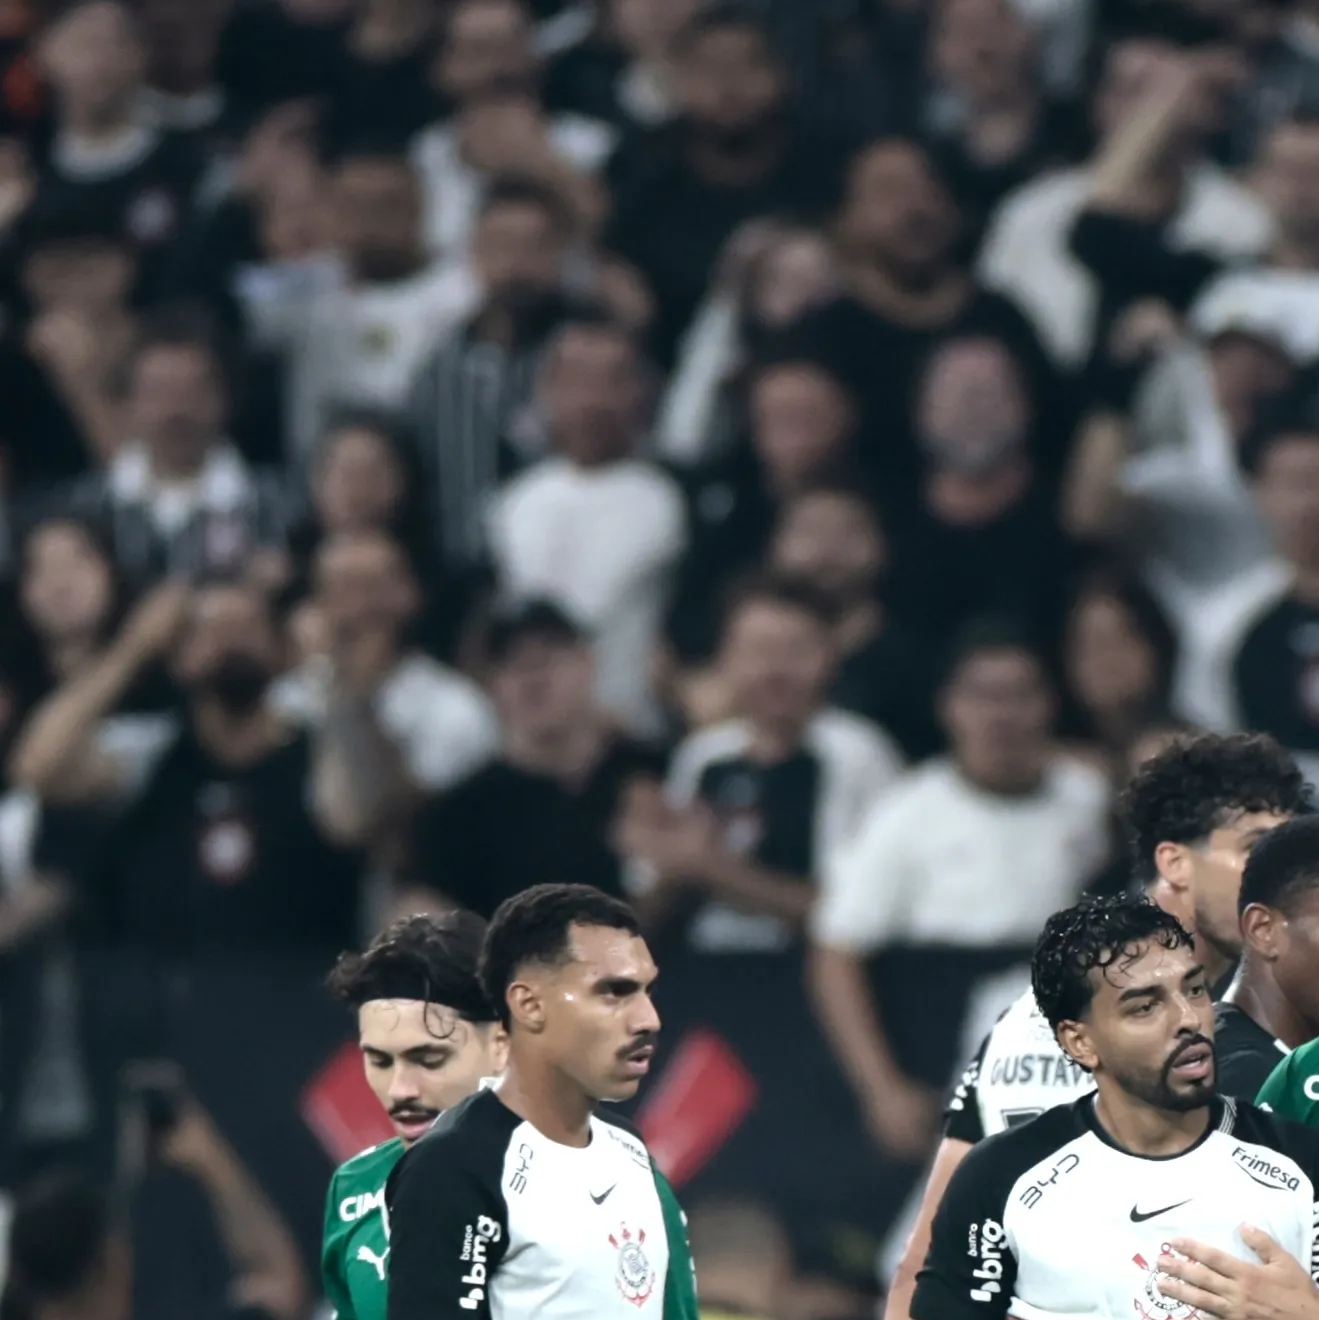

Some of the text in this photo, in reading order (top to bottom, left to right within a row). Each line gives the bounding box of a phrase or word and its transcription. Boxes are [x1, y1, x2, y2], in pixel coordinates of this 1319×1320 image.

[990, 1053, 1096, 1087] GUSTAV
[1231, 1147, 1300, 1192] Frimesa
[339, 1187, 386, 1222] CIM
[460, 1225, 472, 1260] banco
[462, 1215, 500, 1285] bmg
